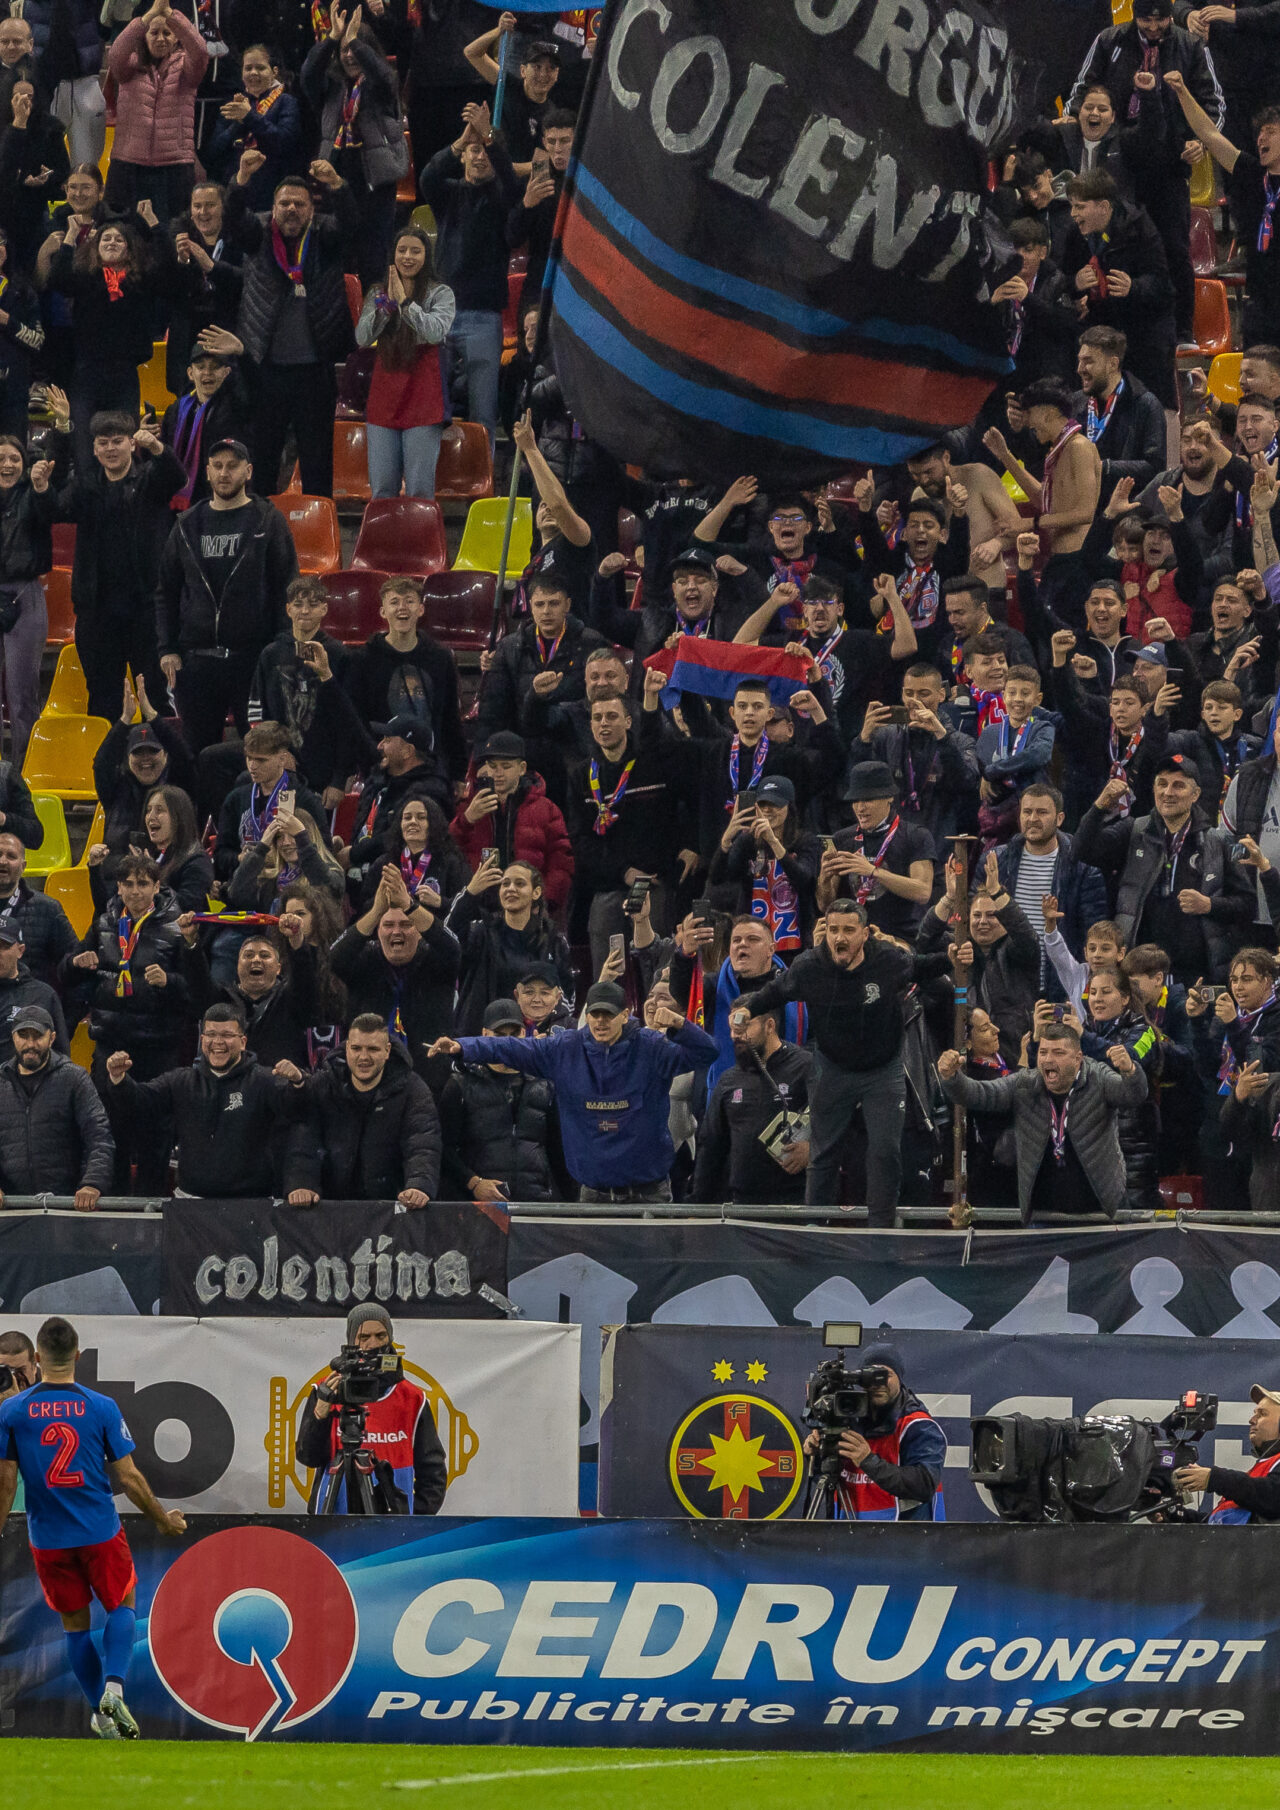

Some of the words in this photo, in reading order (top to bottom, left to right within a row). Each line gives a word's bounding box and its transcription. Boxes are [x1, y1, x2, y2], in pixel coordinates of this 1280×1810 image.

[195, 1234, 470, 1303] colentina
[28, 1401, 85, 1418] CRETU
[41, 1422, 85, 1488] 2
[778, 1456, 793, 1473] B
[392, 1578, 957, 1684] CEDRU
[945, 1637, 1267, 1684] CONCEPT
[368, 1690, 795, 1723] Publicitate
[823, 1696, 900, 1726] în
